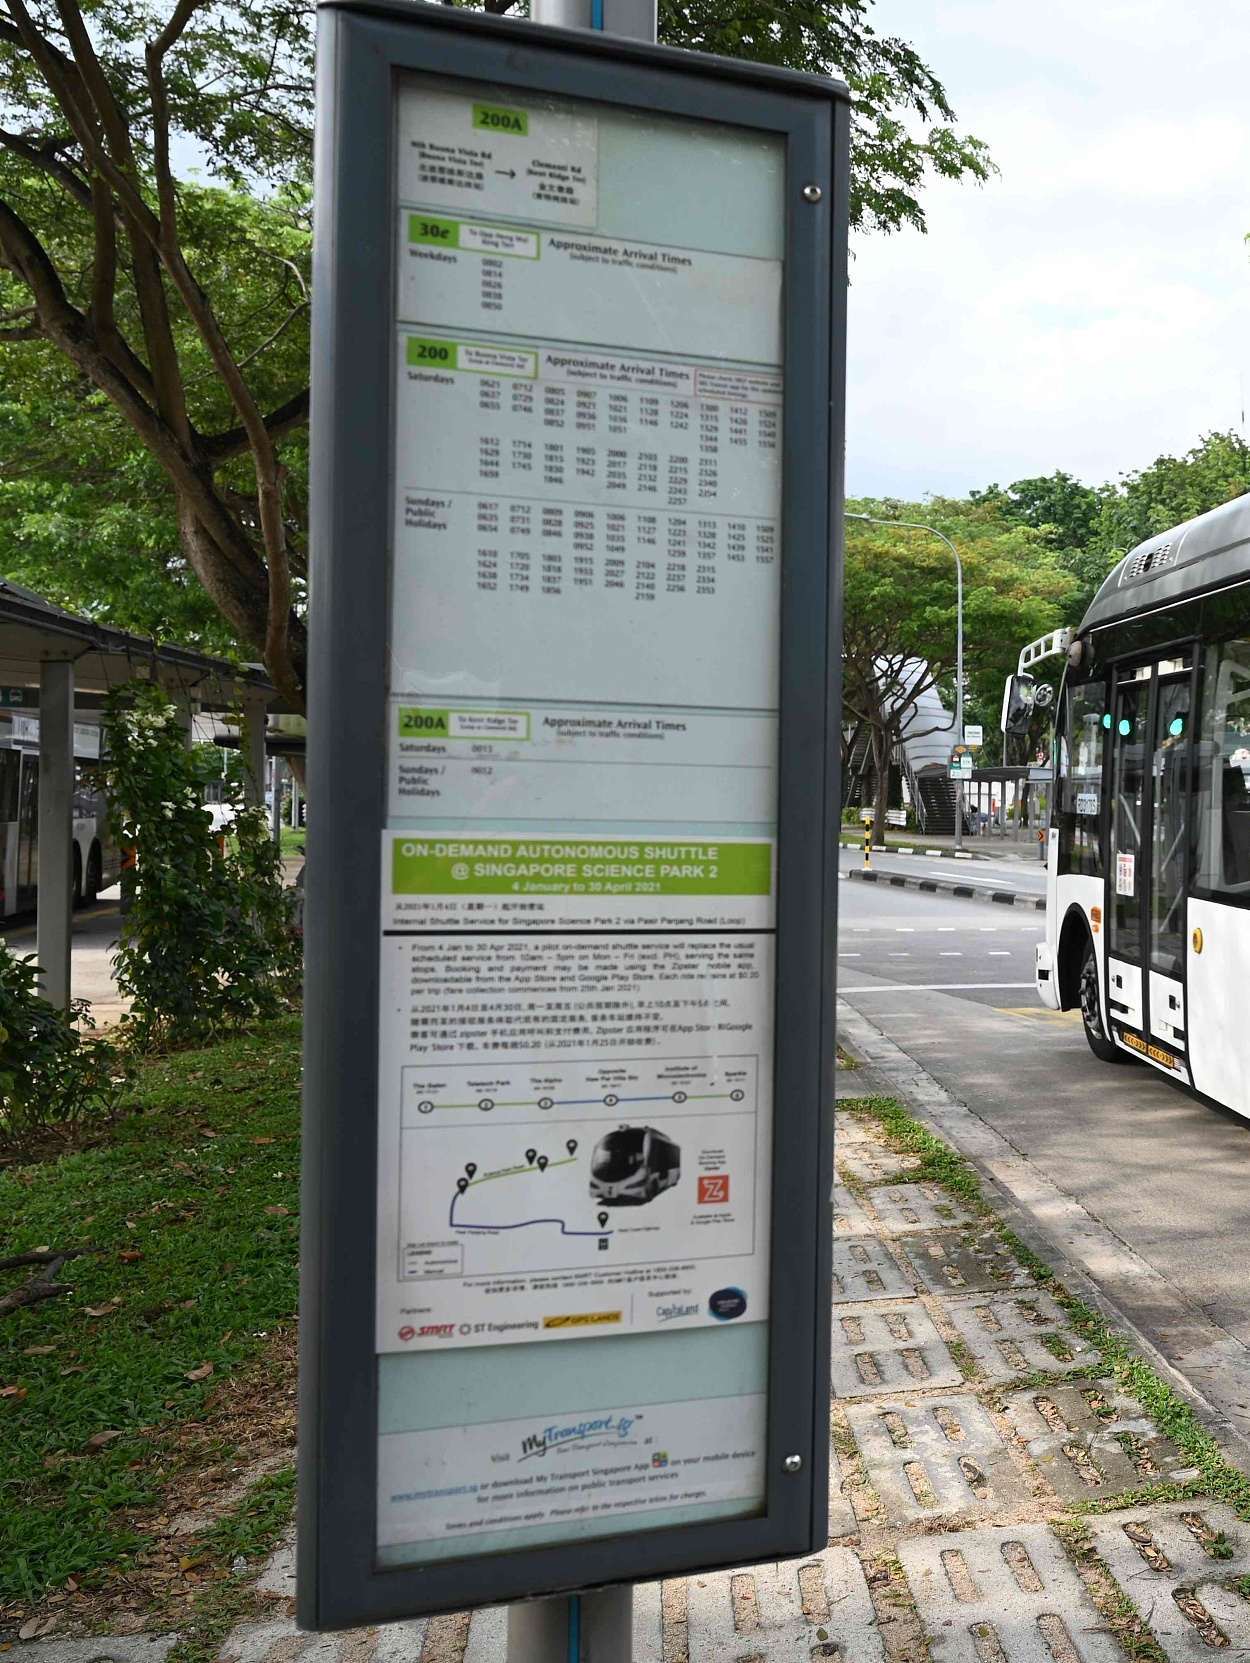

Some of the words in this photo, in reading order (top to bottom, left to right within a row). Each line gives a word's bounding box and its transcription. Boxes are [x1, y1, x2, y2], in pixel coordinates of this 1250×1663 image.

[480, 111, 522, 131] 200A
[420, 222, 449, 240] 30e
[410, 248, 457, 264] Weekdays
[548, 237, 619, 255] Approximate
[621, 247, 658, 262] Arrival
[662, 252, 692, 266] Times
[602, 256, 609, 266] to
[611, 257, 634, 269] traffic
[417, 345, 448, 361] 200
[546, 354, 616, 371] Approximate
[620, 362, 656, 376] Arrival
[658, 366, 690, 380] Times
[408, 371, 454, 386] Saturdays
[599, 373, 606, 381] to
[608, 373, 633, 384] traffic
[405, 496, 445, 509] Sundays
[405, 508, 435, 518] Public
[405, 518, 447, 531] Holidays
[403, 715, 445, 730] 200A
[543, 716, 613, 728] Approximate
[616, 719, 652, 730] Arrival
[654, 720, 686, 731] Times
[598, 730, 620, 738] traffic
[399, 743, 446, 754] Saturdays
[398, 765, 438, 776] Sundays
[398, 776, 429, 785] Public
[398, 787, 441, 797] Holidays
[401, 842, 512, 858] ON-DEMAND
[516, 844, 640, 860] AUTONOMOUS
[644, 846, 718, 860] SHUTTLE
[450, 862, 470, 881] @
[474, 863, 577, 878] SINGAPORE
[582, 864, 655, 878] SCIENCE
[660, 865, 704, 878] PARK
[708, 865, 718, 878] 2
[511, 882, 519, 892] 4
[522, 882, 570, 894] January
[573, 882, 586, 892] to
[588, 882, 602, 892] 30
[604, 882, 632, 894] April
[634, 882, 661, 892] 2021
[392, 917, 426, 925] Internal
[429, 917, 460, 925] Shuttle
[462, 917, 495, 925] Service
[497, 917, 510, 925] for
[512, 917, 555, 927] Singapore
[558, 917, 591, 925] Science
[594, 917, 612, 925] Park
[624, 917, 635, 925] via
[660, 917, 694, 927] Panjang
[696, 917, 717, 925] Road
[648, 1289, 680, 1298] Supported
[656, 1302, 699, 1316] CapitaLand
[571, 1315, 588, 1324] GPS
[590, 1313, 620, 1322] LANDS
[418, 1323, 456, 1337] SMRT
[474, 1323, 486, 1334] ST
[488, 1321, 539, 1334] Engineering
[490, 1453, 510, 1464] Visit
[644, 1436, 652, 1444] at
[480, 1482, 489, 1490] or
[491, 1476, 533, 1489] download
[535, 1474, 547, 1484] My
[550, 1470, 590, 1482] Transport
[592, 1464, 632, 1477] Singapore
[634, 1462, 650, 1472] App
[670, 1458, 681, 1466] on
[682, 1458, 700, 1466] your
[702, 1452, 730, 1462] mobile
[732, 1450, 756, 1459] device
[476, 1495, 489, 1504] for
[492, 1494, 514, 1502] more
[516, 1486, 566, 1499] information
[568, 1484, 579, 1492] on
[581, 1480, 606, 1491] public
[608, 1476, 646, 1487] transport
[648, 1472, 679, 1482] services
